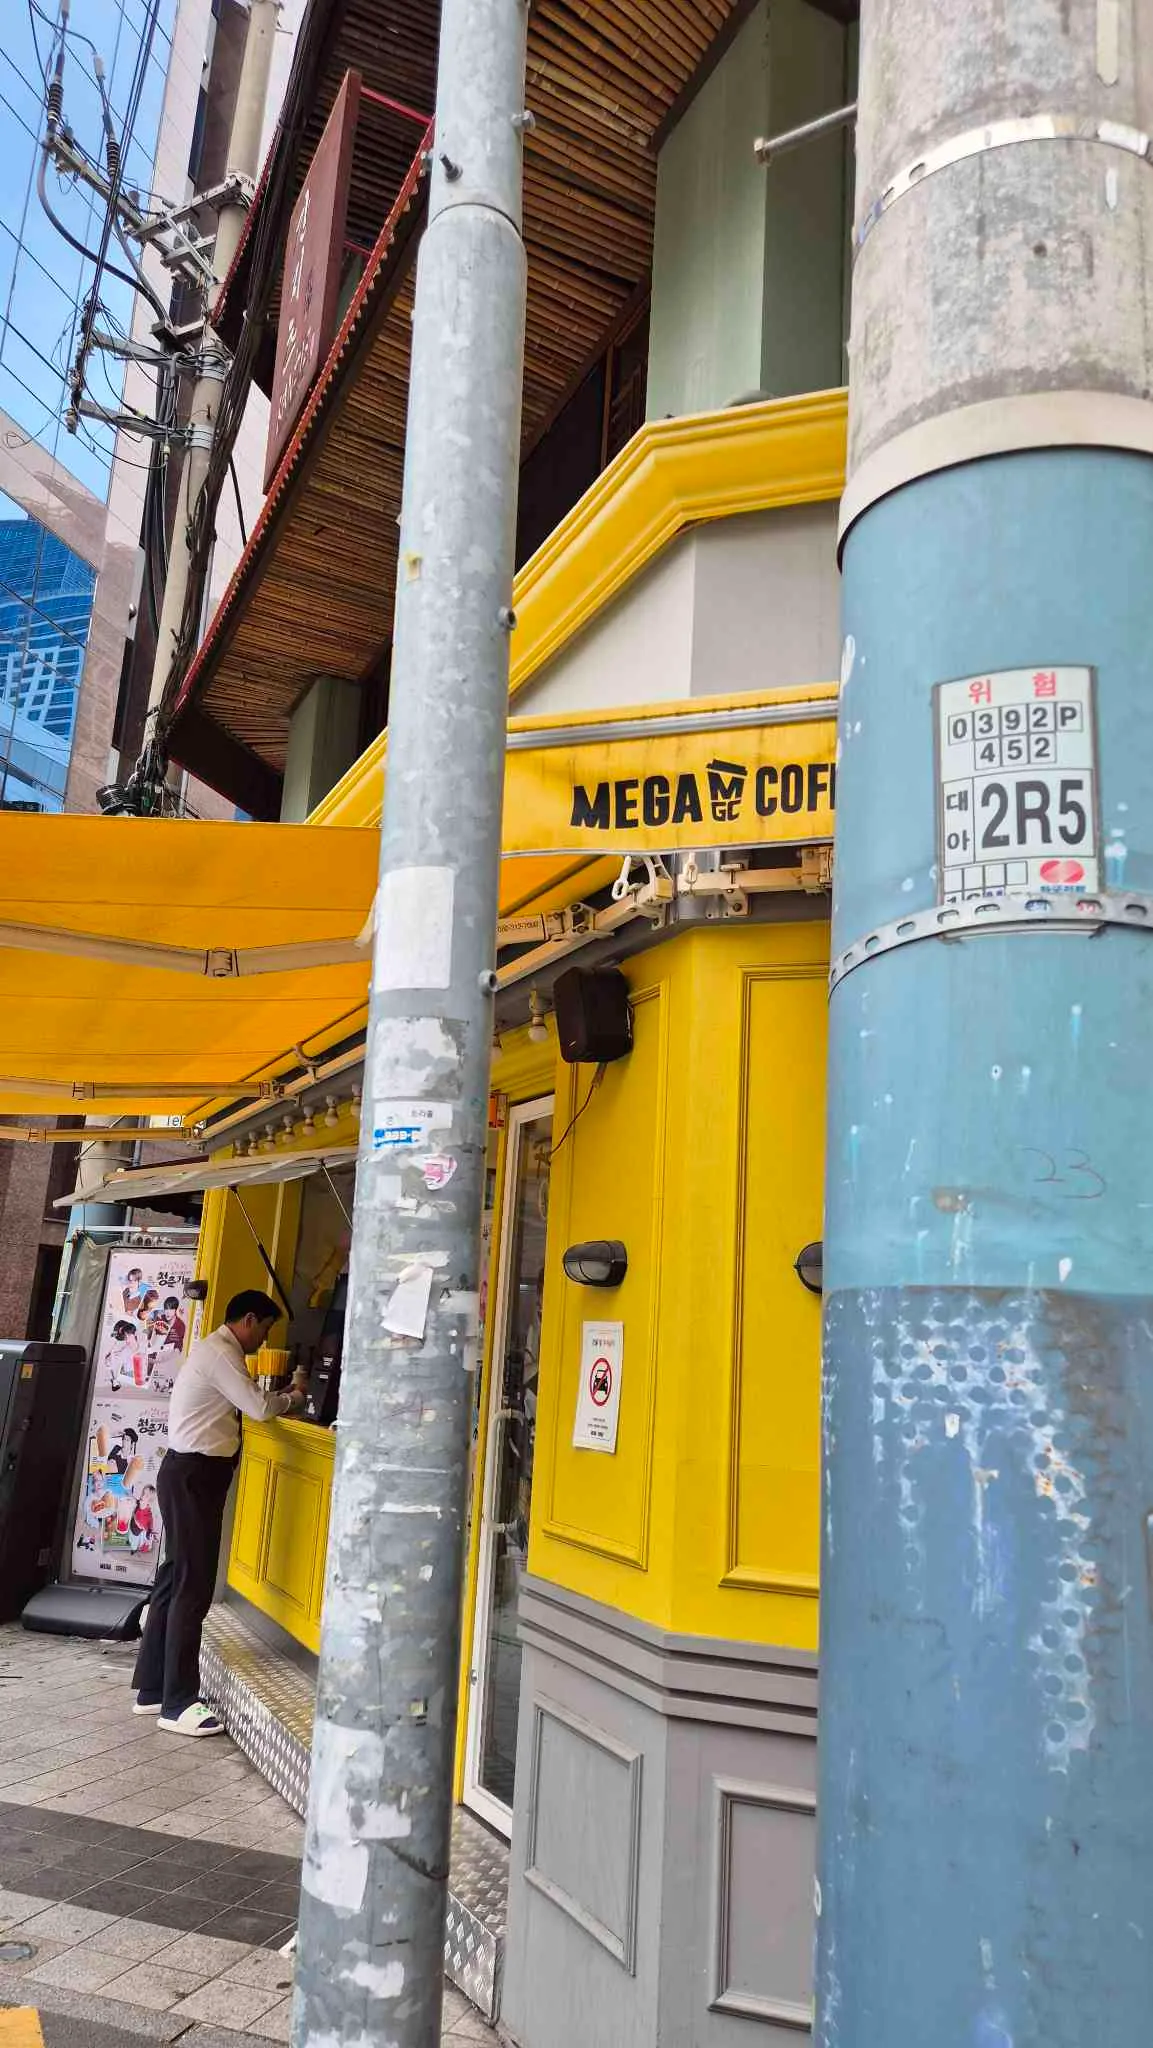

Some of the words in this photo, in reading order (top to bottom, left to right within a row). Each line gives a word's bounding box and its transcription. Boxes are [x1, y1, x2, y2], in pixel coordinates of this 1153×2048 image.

[952, 706, 1077, 739] 0392P
[979, 738, 1051, 763] 452
[570, 773, 703, 830] MEGA
[980, 779, 1087, 848] 2R5
